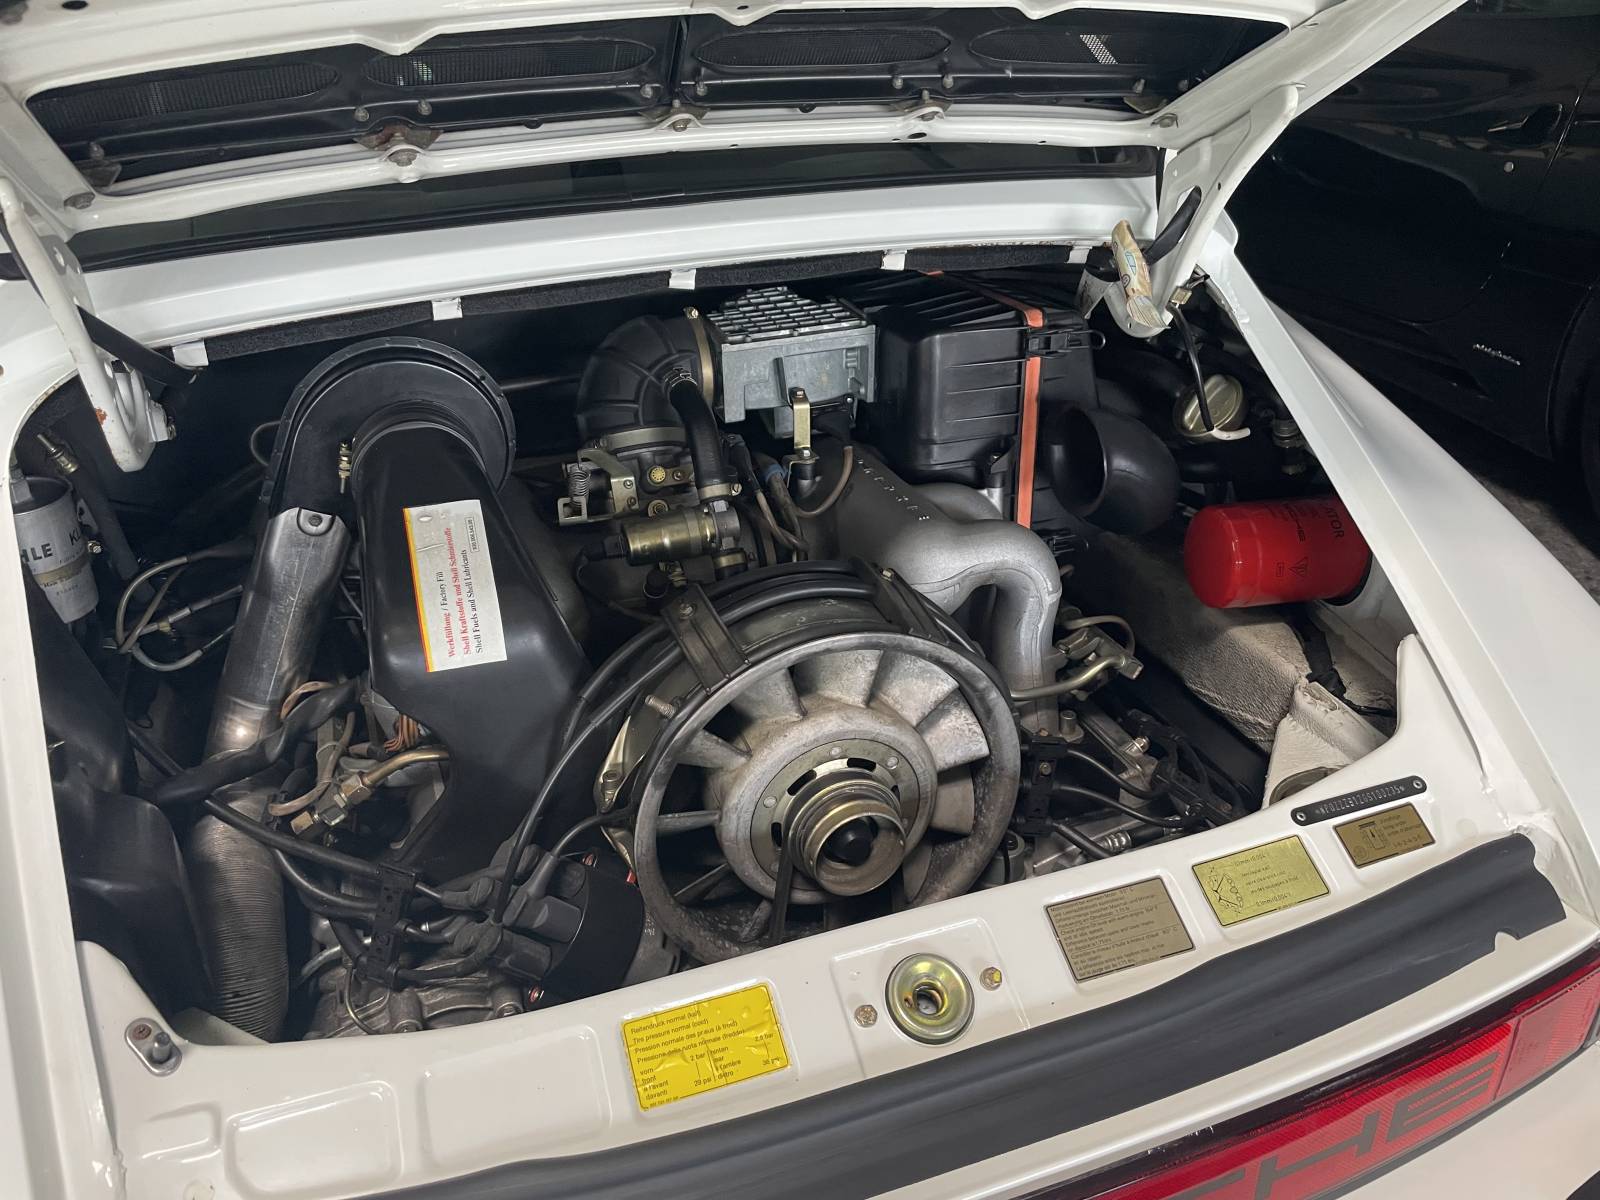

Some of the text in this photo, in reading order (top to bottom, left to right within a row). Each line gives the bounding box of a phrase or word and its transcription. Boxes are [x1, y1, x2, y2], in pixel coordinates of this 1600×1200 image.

[438, 583, 448, 606] Factory
[444, 527, 471, 655] Shell Kraftstoffe und Shell Schmierstoffe
[461, 549, 483, 654] Shell Fuels and Shell Lubricants
[444, 612, 456, 657] Werkfüllung
[666, 1014, 686, 1025] normal
[645, 1030, 671, 1042] pressure
[671, 1024, 692, 1035] normal
[635, 1042, 660, 1054] Pression
[661, 1036, 684, 1048] normale
[695, 1052, 706, 1060] bar
[639, 1067, 654, 1075] vorn
[641, 1074, 656, 1084] front
